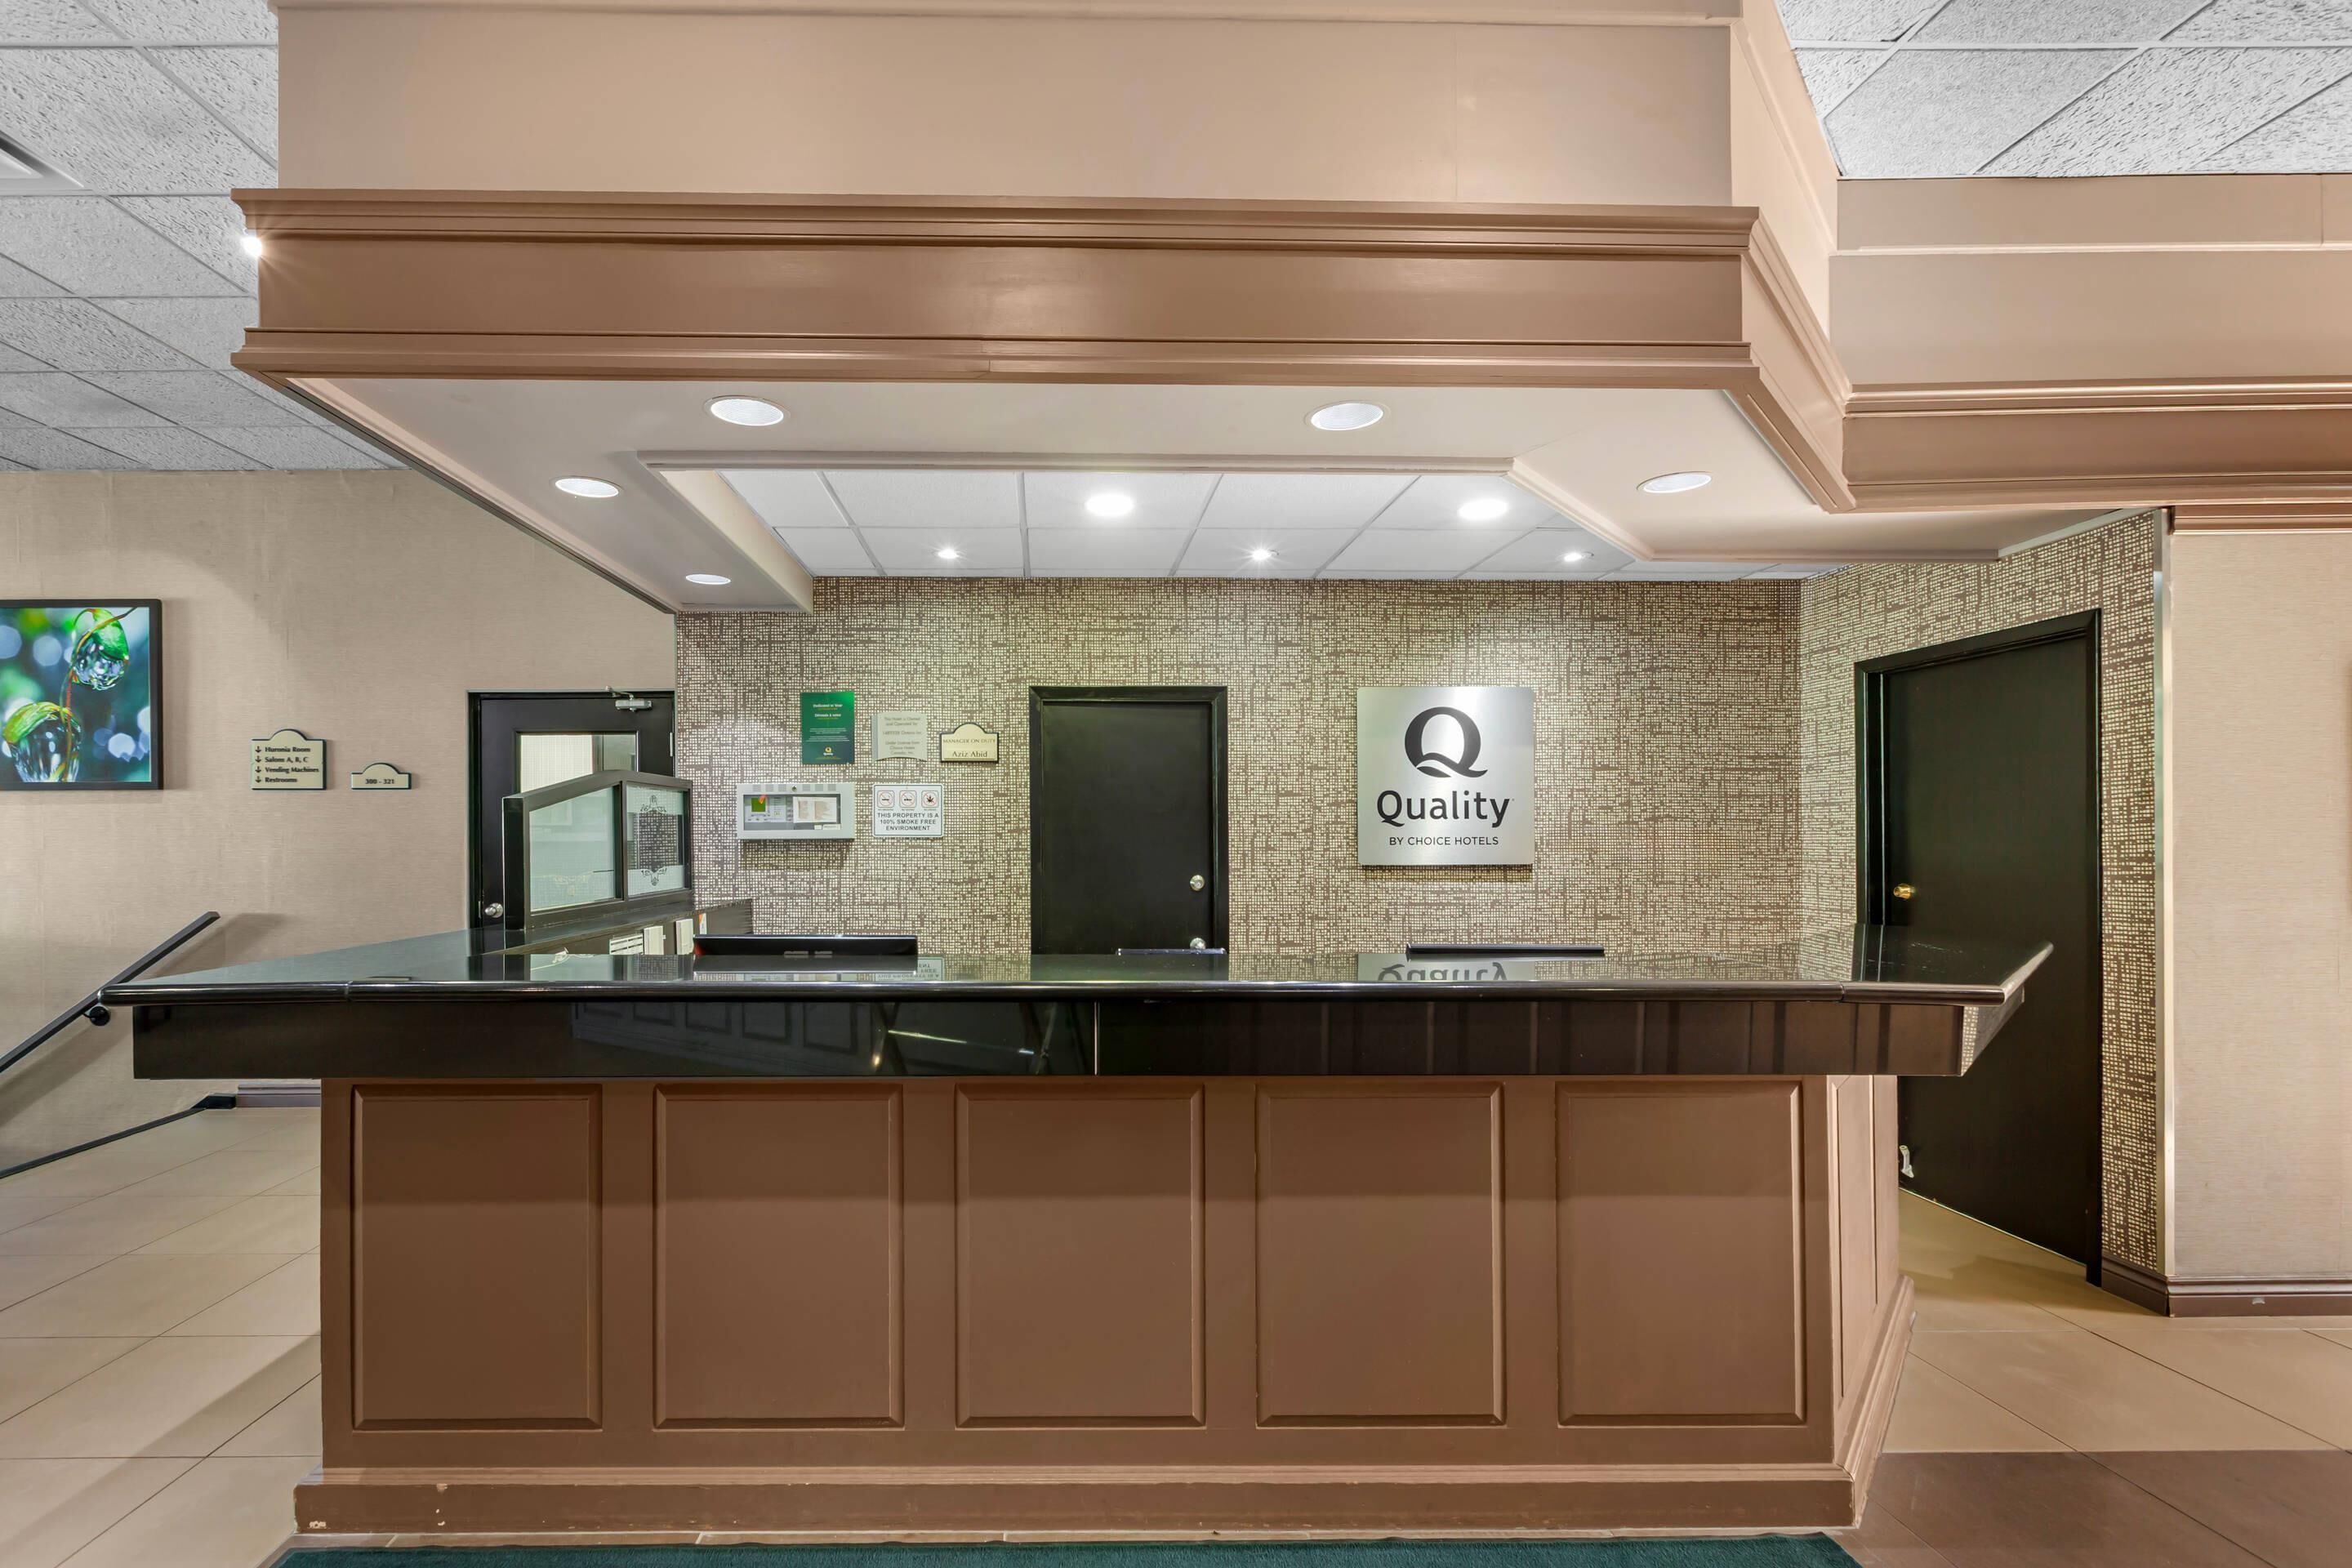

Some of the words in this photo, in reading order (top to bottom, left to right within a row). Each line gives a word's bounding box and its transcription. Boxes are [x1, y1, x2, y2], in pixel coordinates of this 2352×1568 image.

[1405, 706, 1488, 778] Q
[1377, 790, 1510, 828] Quality
[1389, 836, 1404, 845] BY
[1407, 836, 1450, 845] CHOICE
[1454, 836, 1499, 845] HOTELS
